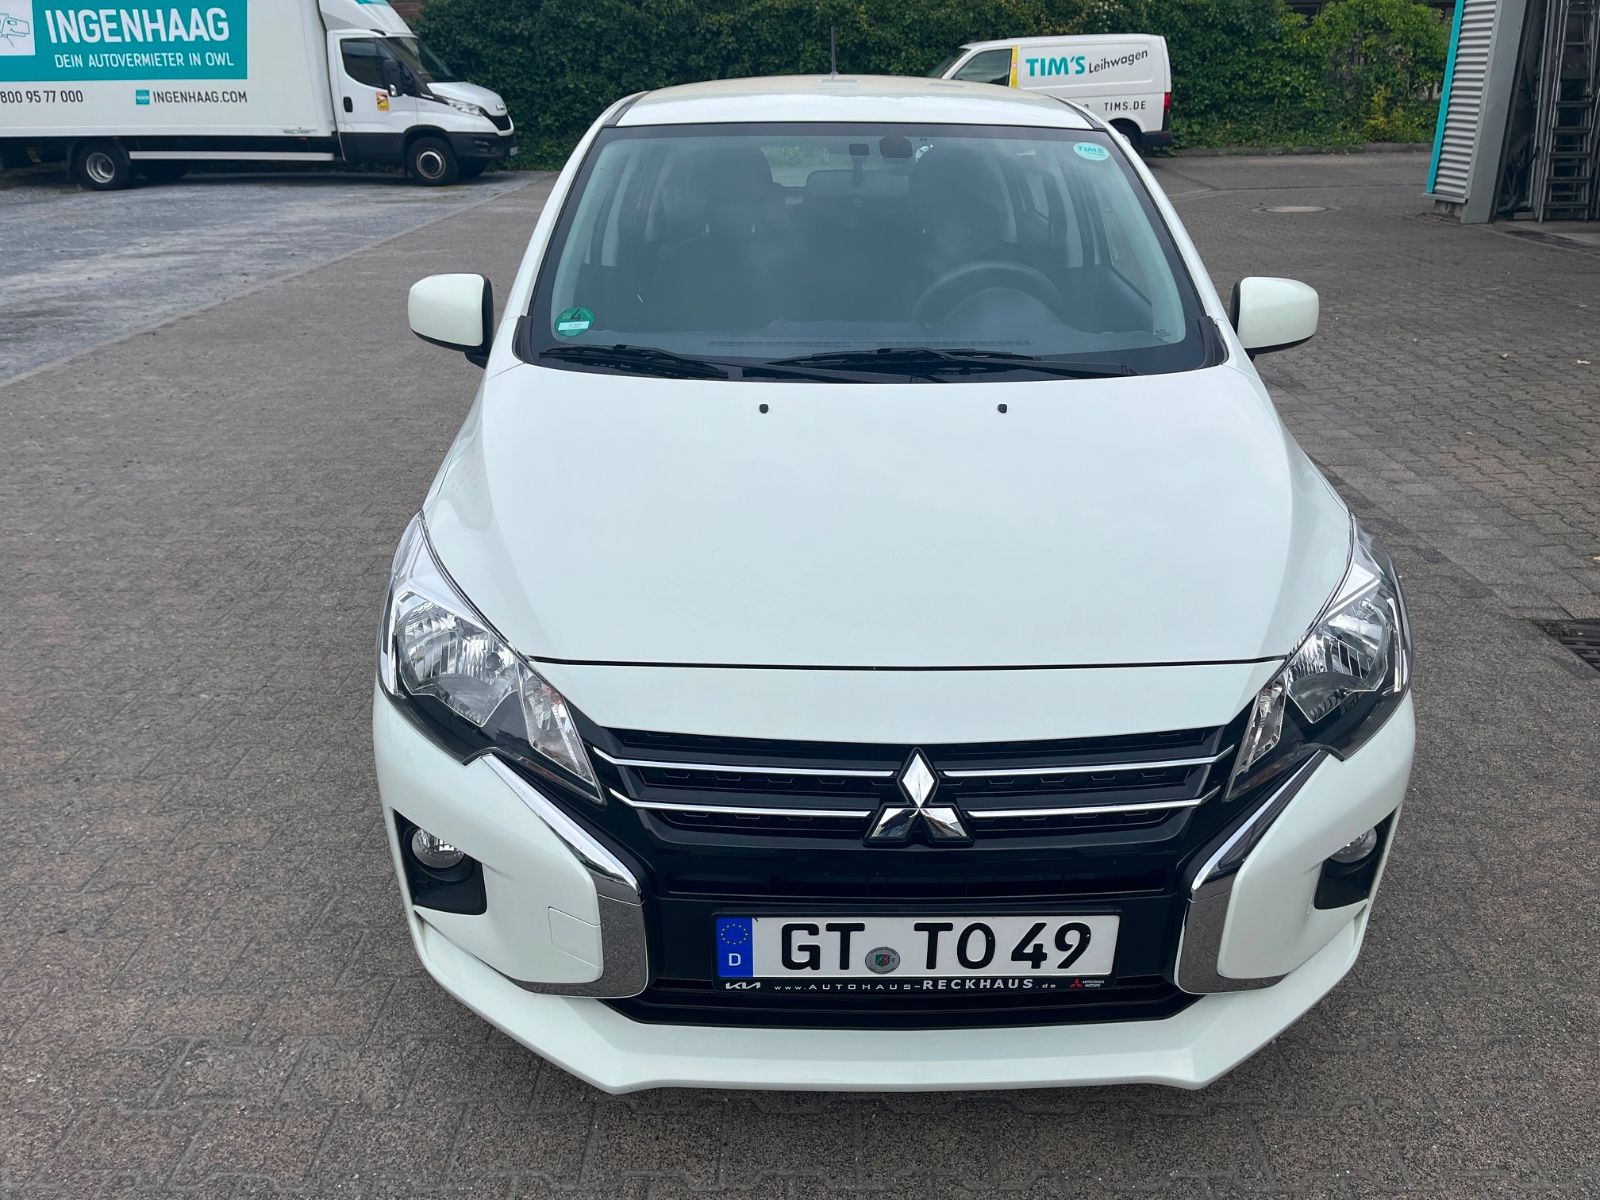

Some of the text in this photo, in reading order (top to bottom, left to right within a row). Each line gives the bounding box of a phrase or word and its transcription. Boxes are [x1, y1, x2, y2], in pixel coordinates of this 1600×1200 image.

[45, 7, 230, 44] INGENHAAG
[54, 52, 235, 69] DEIN AUTOVERMIETER IN OWL
[1026, 50, 1148, 77] TIM'S Leihwagen
[26, 90, 41, 103] 95
[43, 90, 56, 103] 77
[60, 90, 84, 103] 000
[152, 91, 248, 104] INGENHAAG.COM
[1104, 100, 1146, 111] TIMS.DE
[781, 922, 865, 970] GT
[913, 922, 996, 970] TO
[1010, 922, 1091, 970] 49
[728, 953, 742, 967] D
